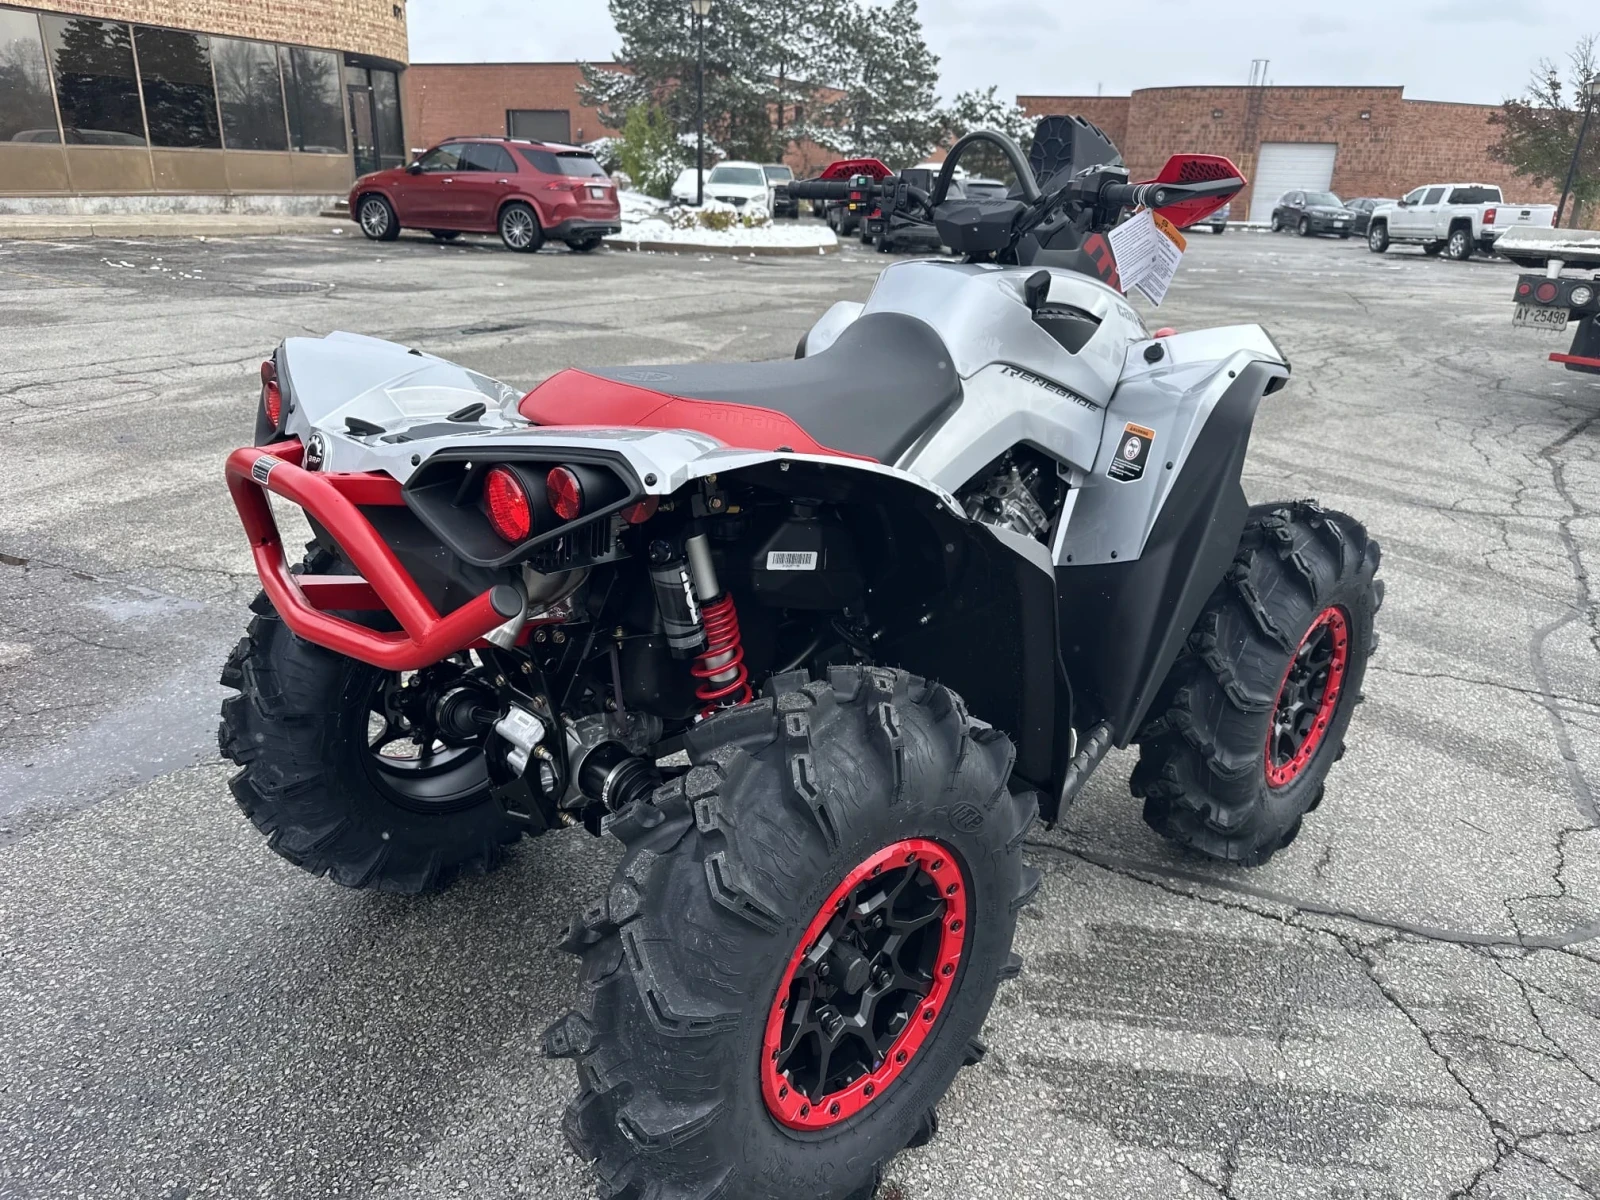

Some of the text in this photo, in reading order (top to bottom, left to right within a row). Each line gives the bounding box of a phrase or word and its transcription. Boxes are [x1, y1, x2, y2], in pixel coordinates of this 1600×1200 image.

[1516, 307, 1566, 324] AY 25498
[1000, 366, 1100, 412] RENEGADE
[308, 454, 321, 464] BRP
[953, 805, 984, 829] ITP
